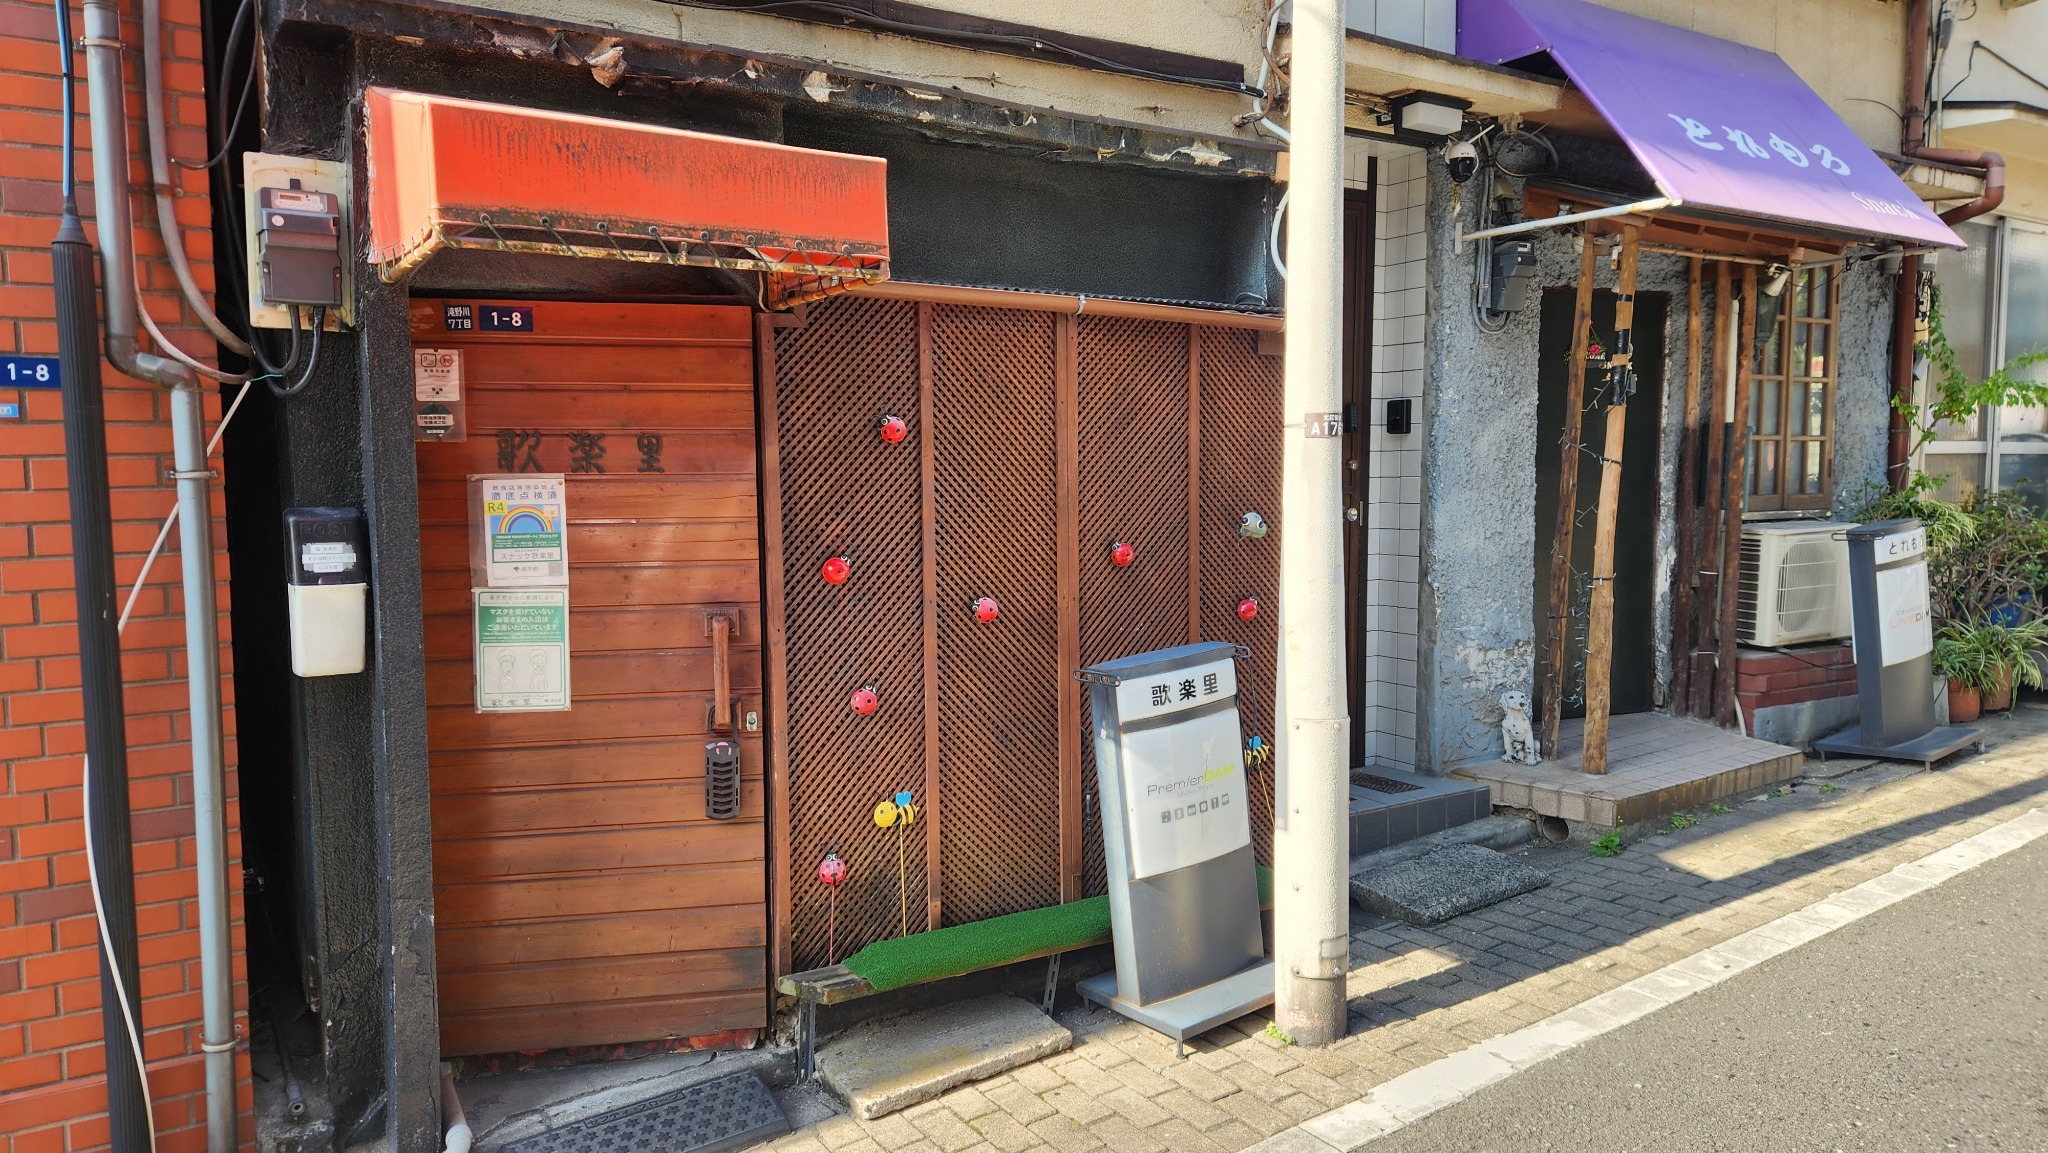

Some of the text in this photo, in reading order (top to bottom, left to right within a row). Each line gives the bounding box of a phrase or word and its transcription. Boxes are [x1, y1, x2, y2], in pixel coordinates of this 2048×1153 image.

[1850, 190, 1920, 220] Snack
[447, 306, 470, 317] 滝野川
[490, 311, 522, 327] 1-8
[448, 319, 472, 329] 7丁目
[7, 362, 50, 382] 1-8
[496, 430, 665, 474] 歌楽里
[491, 491, 557, 500] 徹底点検済
[488, 502, 504, 512] R4
[299, 521, 352, 537] POST
[1151, 673, 1219, 706] 歌楽里
